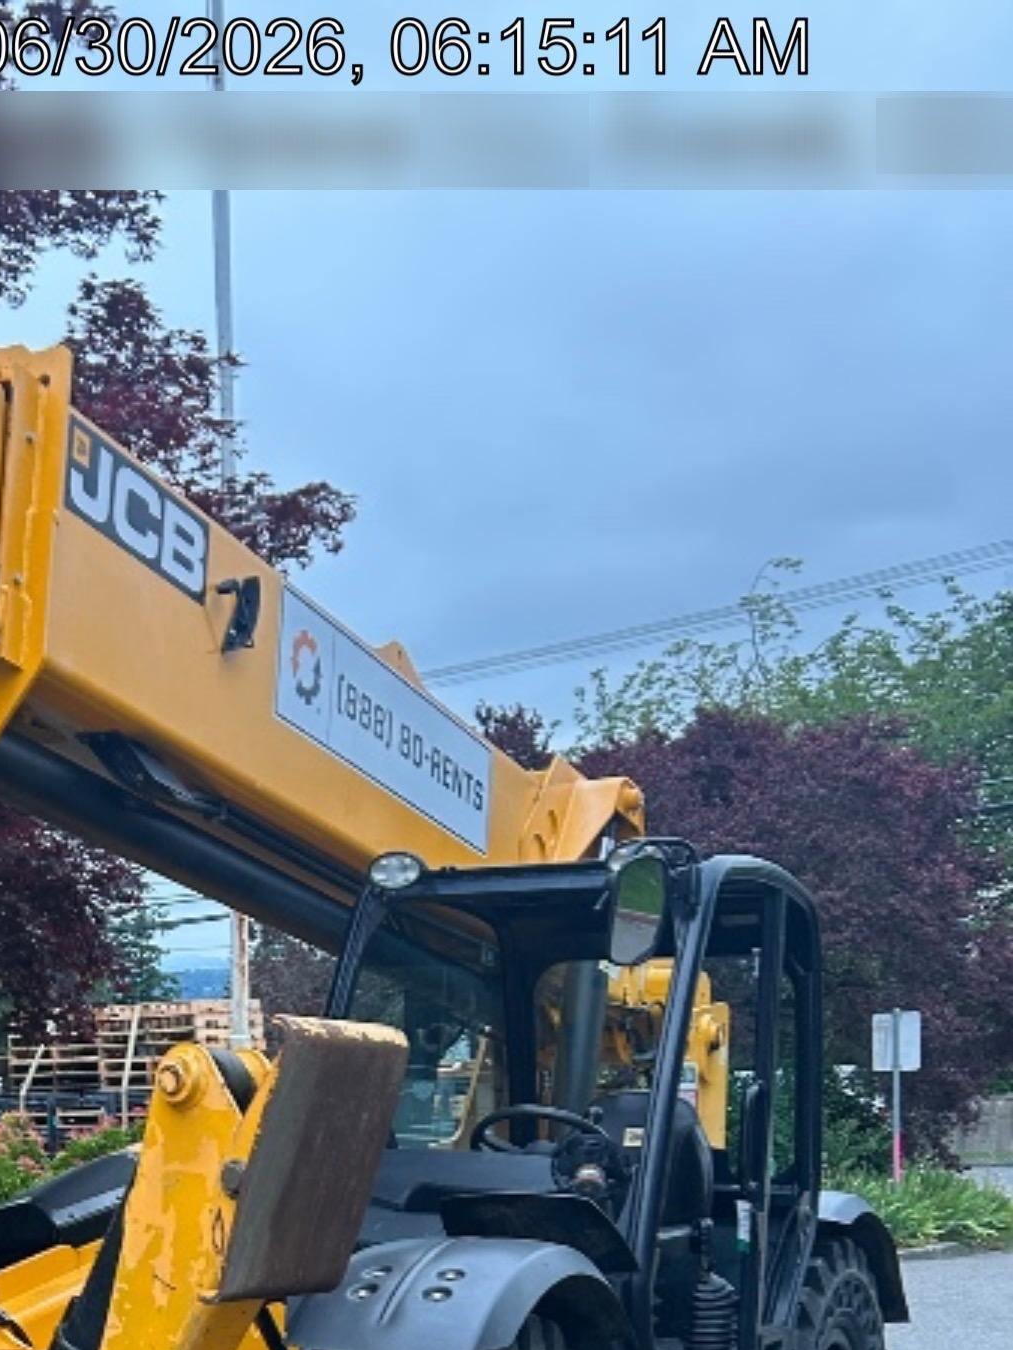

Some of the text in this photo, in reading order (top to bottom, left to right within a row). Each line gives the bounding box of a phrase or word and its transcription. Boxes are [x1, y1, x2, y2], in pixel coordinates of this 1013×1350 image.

[70, 446, 205, 592] JCB
[337, 673, 485, 811] (888) 80-RENTS
